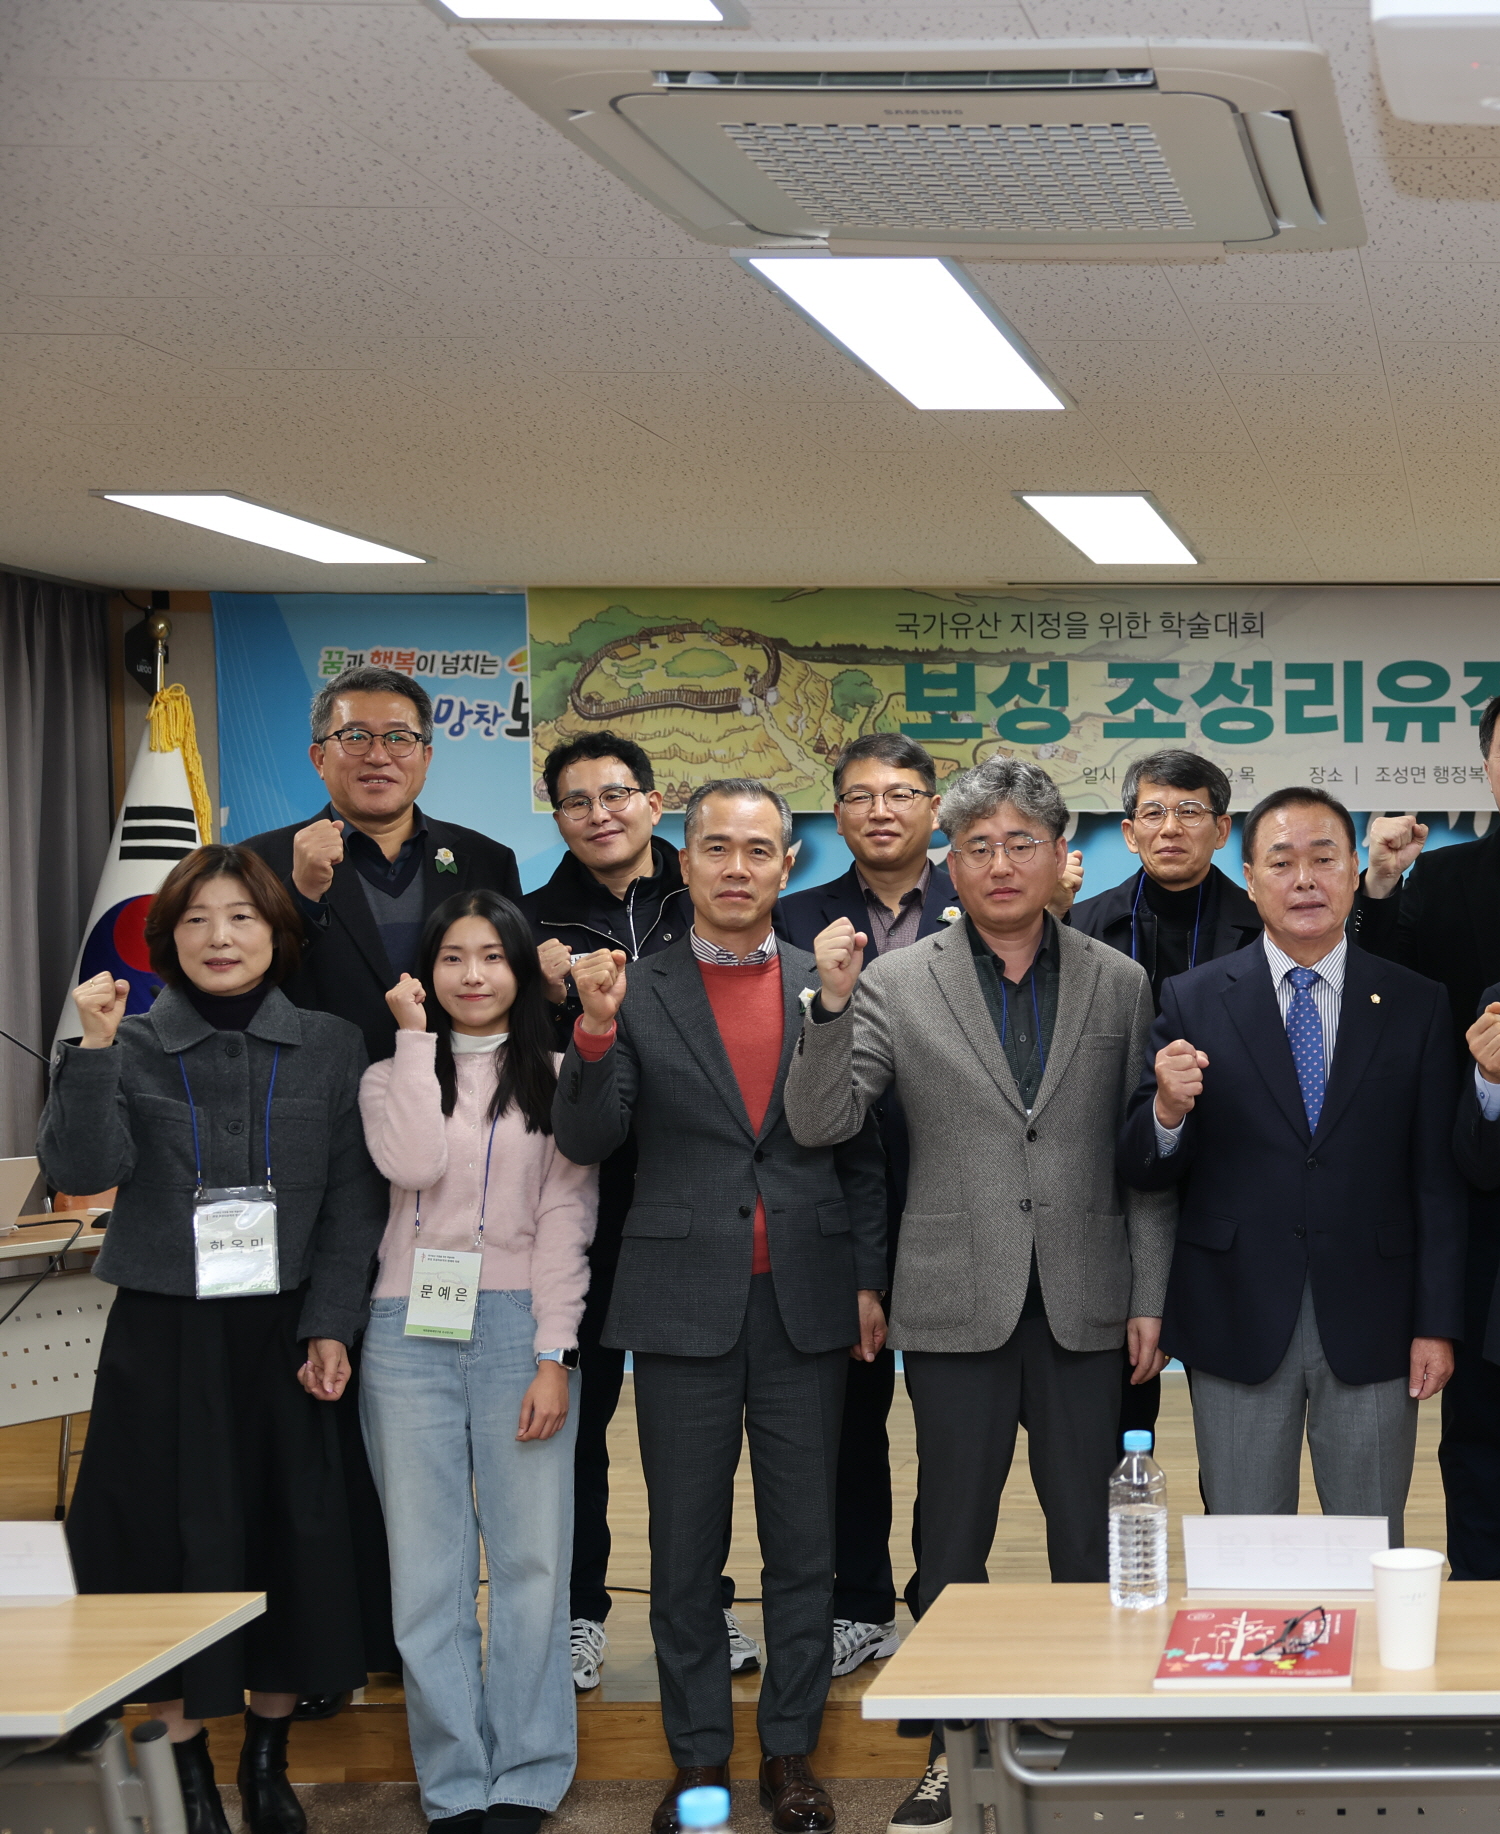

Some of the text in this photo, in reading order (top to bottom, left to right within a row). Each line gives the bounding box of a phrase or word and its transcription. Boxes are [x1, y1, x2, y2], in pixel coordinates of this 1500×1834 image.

[895, 611, 1265, 640] 국가유산 지정을 위한 학술대회
[370, 650, 435, 675] 행복이
[440, 653, 500, 675] 넘치는
[900, 660, 1072, 745] 보성
[1082, 766, 1116, 785] 일시
[1308, 765, 1344, 785] 장소
[1374, 765, 1427, 785] 조성면
